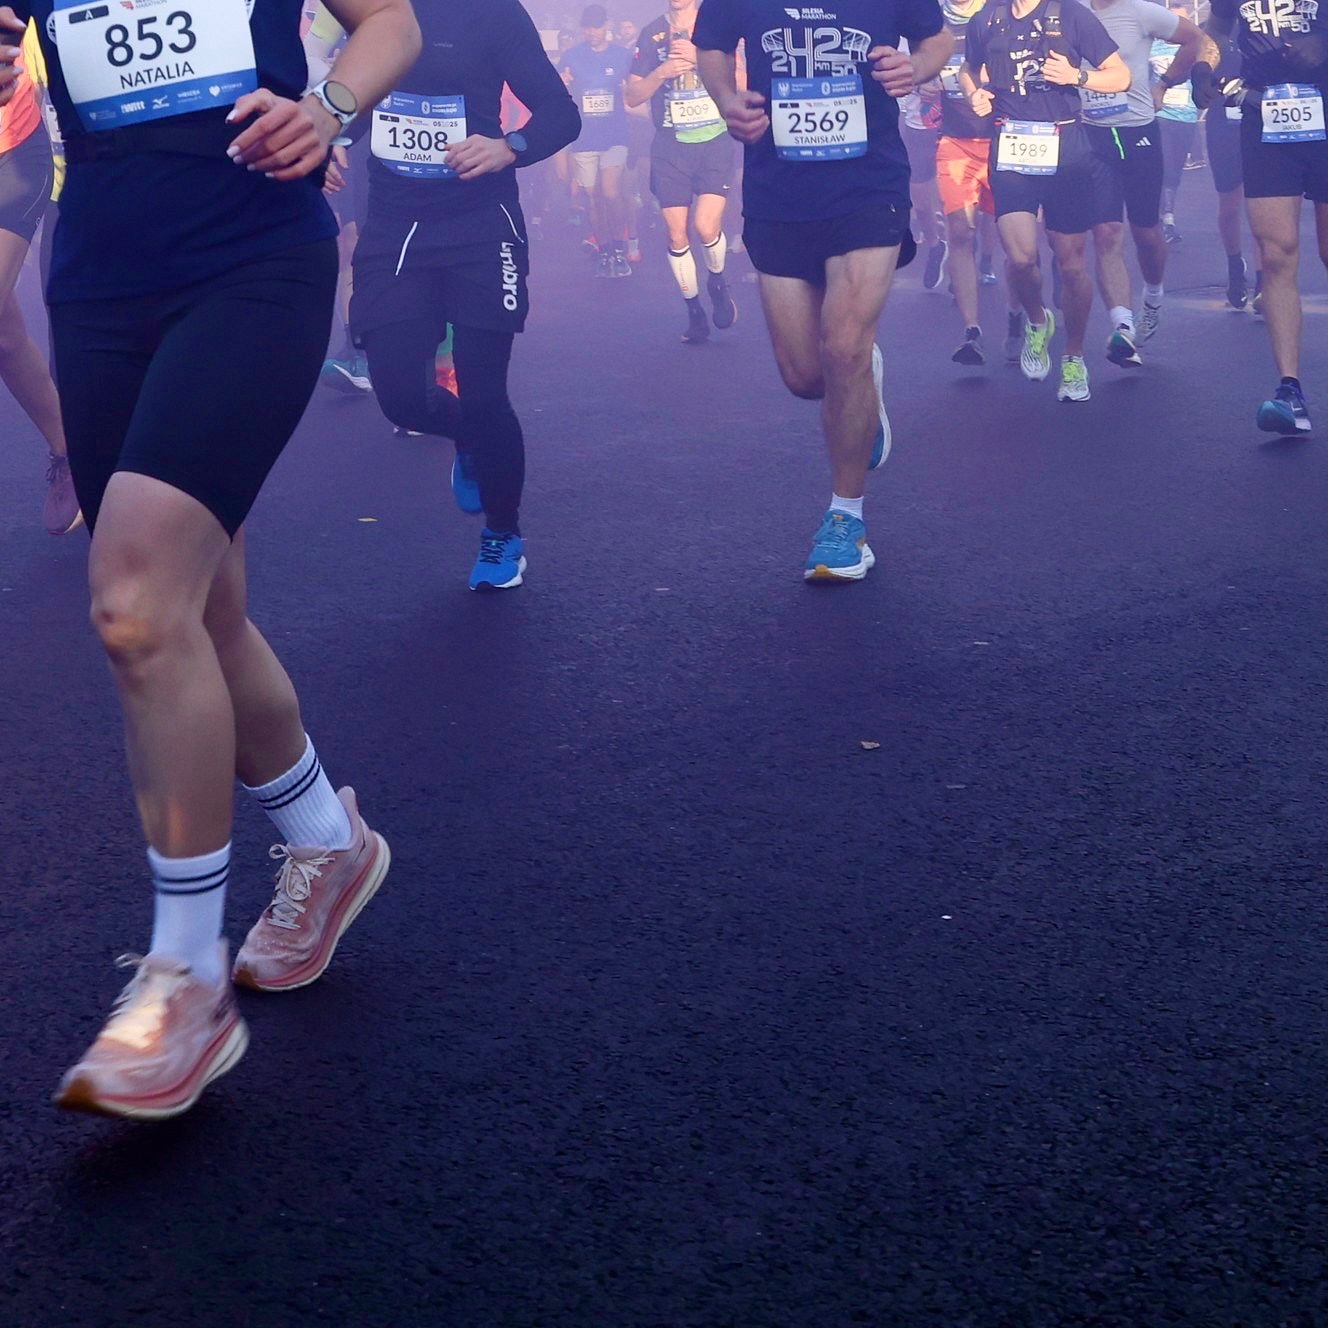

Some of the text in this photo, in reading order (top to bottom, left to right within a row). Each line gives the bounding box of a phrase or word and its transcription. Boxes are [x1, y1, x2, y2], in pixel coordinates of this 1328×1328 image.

[104, 9, 198, 68] 853
[119, 60, 196, 90] NATALIA
[679, 103, 709, 117] 2009
[1270, 106, 1313, 124] 2505
[787, 110, 849, 134] 2569
[388, 126, 449, 152] 1308
[794, 134, 846, 145] STANISŁAW
[403, 152, 432, 162] ADAM
[1010, 142, 1048, 157] 1989
